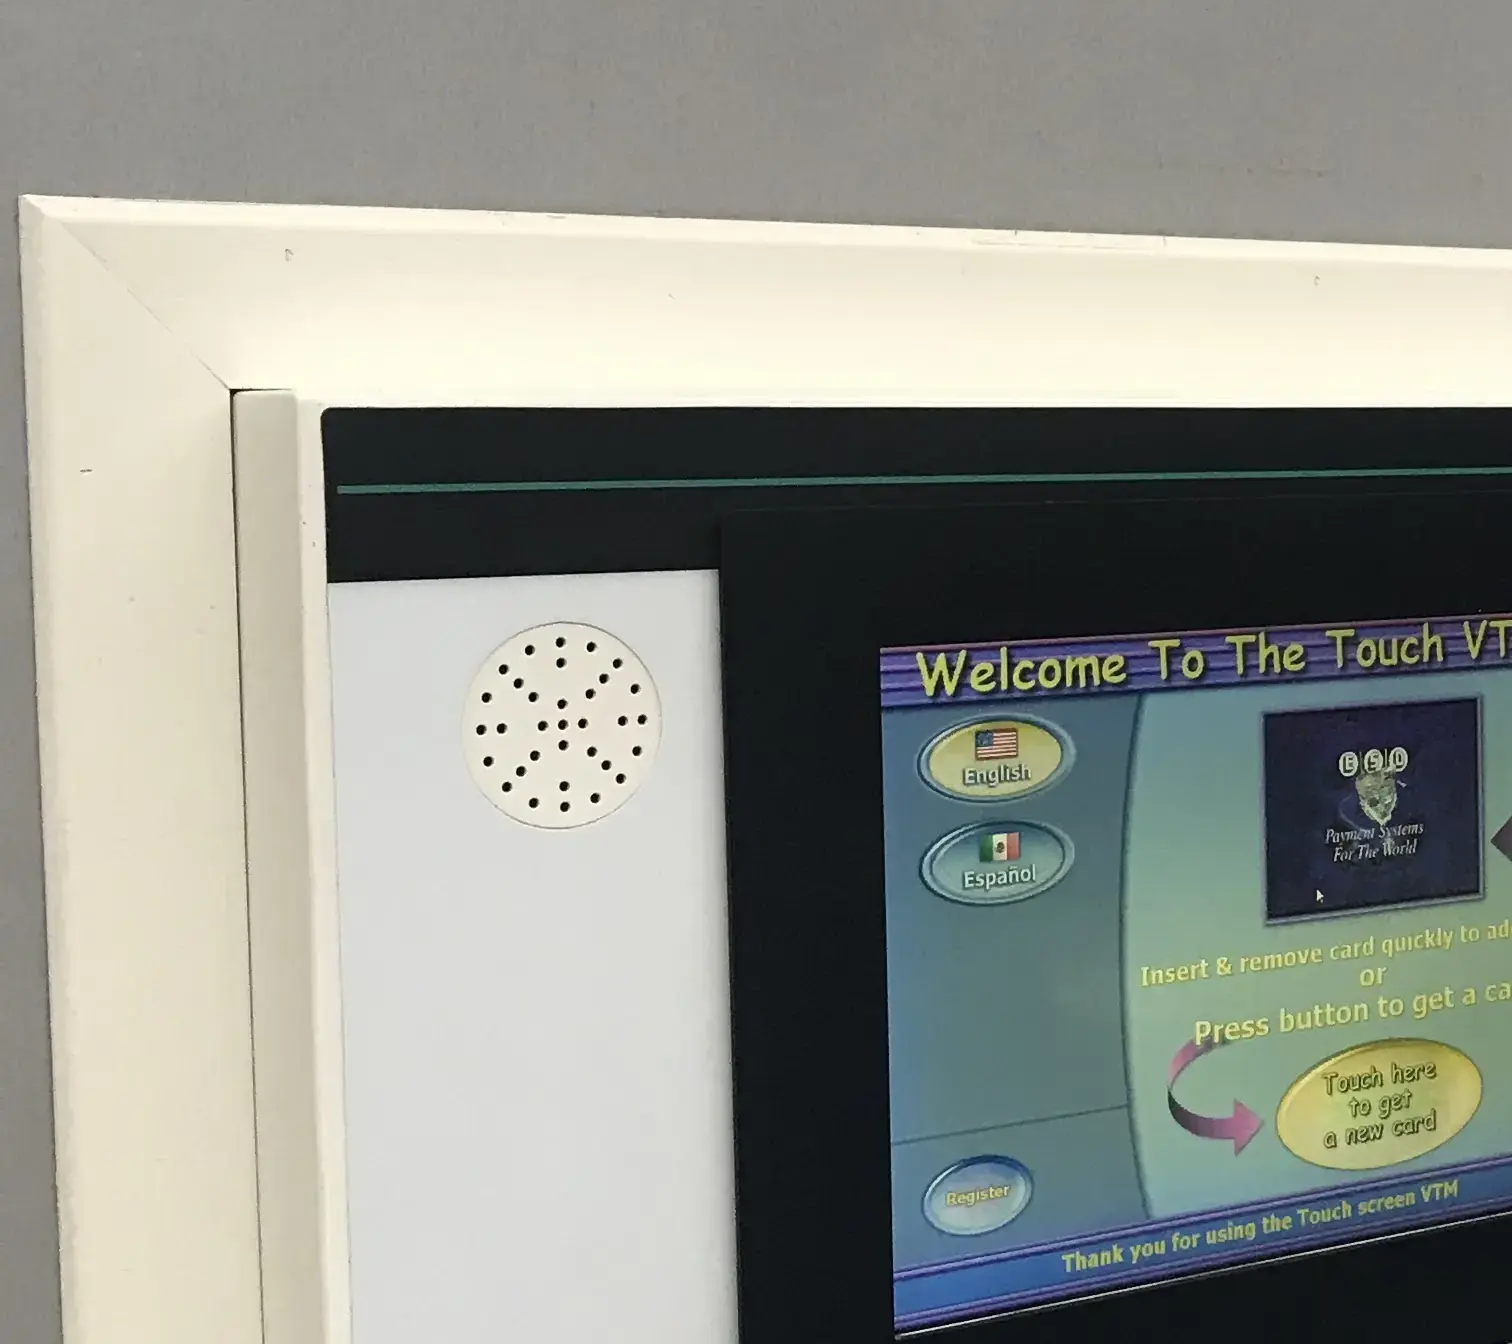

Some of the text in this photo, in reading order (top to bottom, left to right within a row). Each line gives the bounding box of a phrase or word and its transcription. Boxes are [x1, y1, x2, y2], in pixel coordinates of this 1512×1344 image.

[916, 649, 1127, 698] Welcome
[1148, 638, 1205, 681] To
[1226, 632, 1305, 675] The
[1326, 622, 1444, 670] Touch
[962, 761, 1031, 790] English
[962, 863, 1037, 892] Español
[1141, 959, 1208, 986] Insert
[1240, 949, 1322, 972] remove
[1330, 936, 1373, 959] card
[1382, 928, 1453, 957] quickly
[1192, 1014, 1268, 1045] Press
[1280, 1003, 1367, 1032] button
[1413, 987, 1454, 1018] get
[1323, 1063, 1437, 1095] Touch here
[1349, 1089, 1412, 1118] to get
[1347, 1108, 1436, 1145] new card
[946, 1186, 1009, 1208] Register
[1062, 1179, 1458, 1272] Thank you for using the Touch screen VTM
